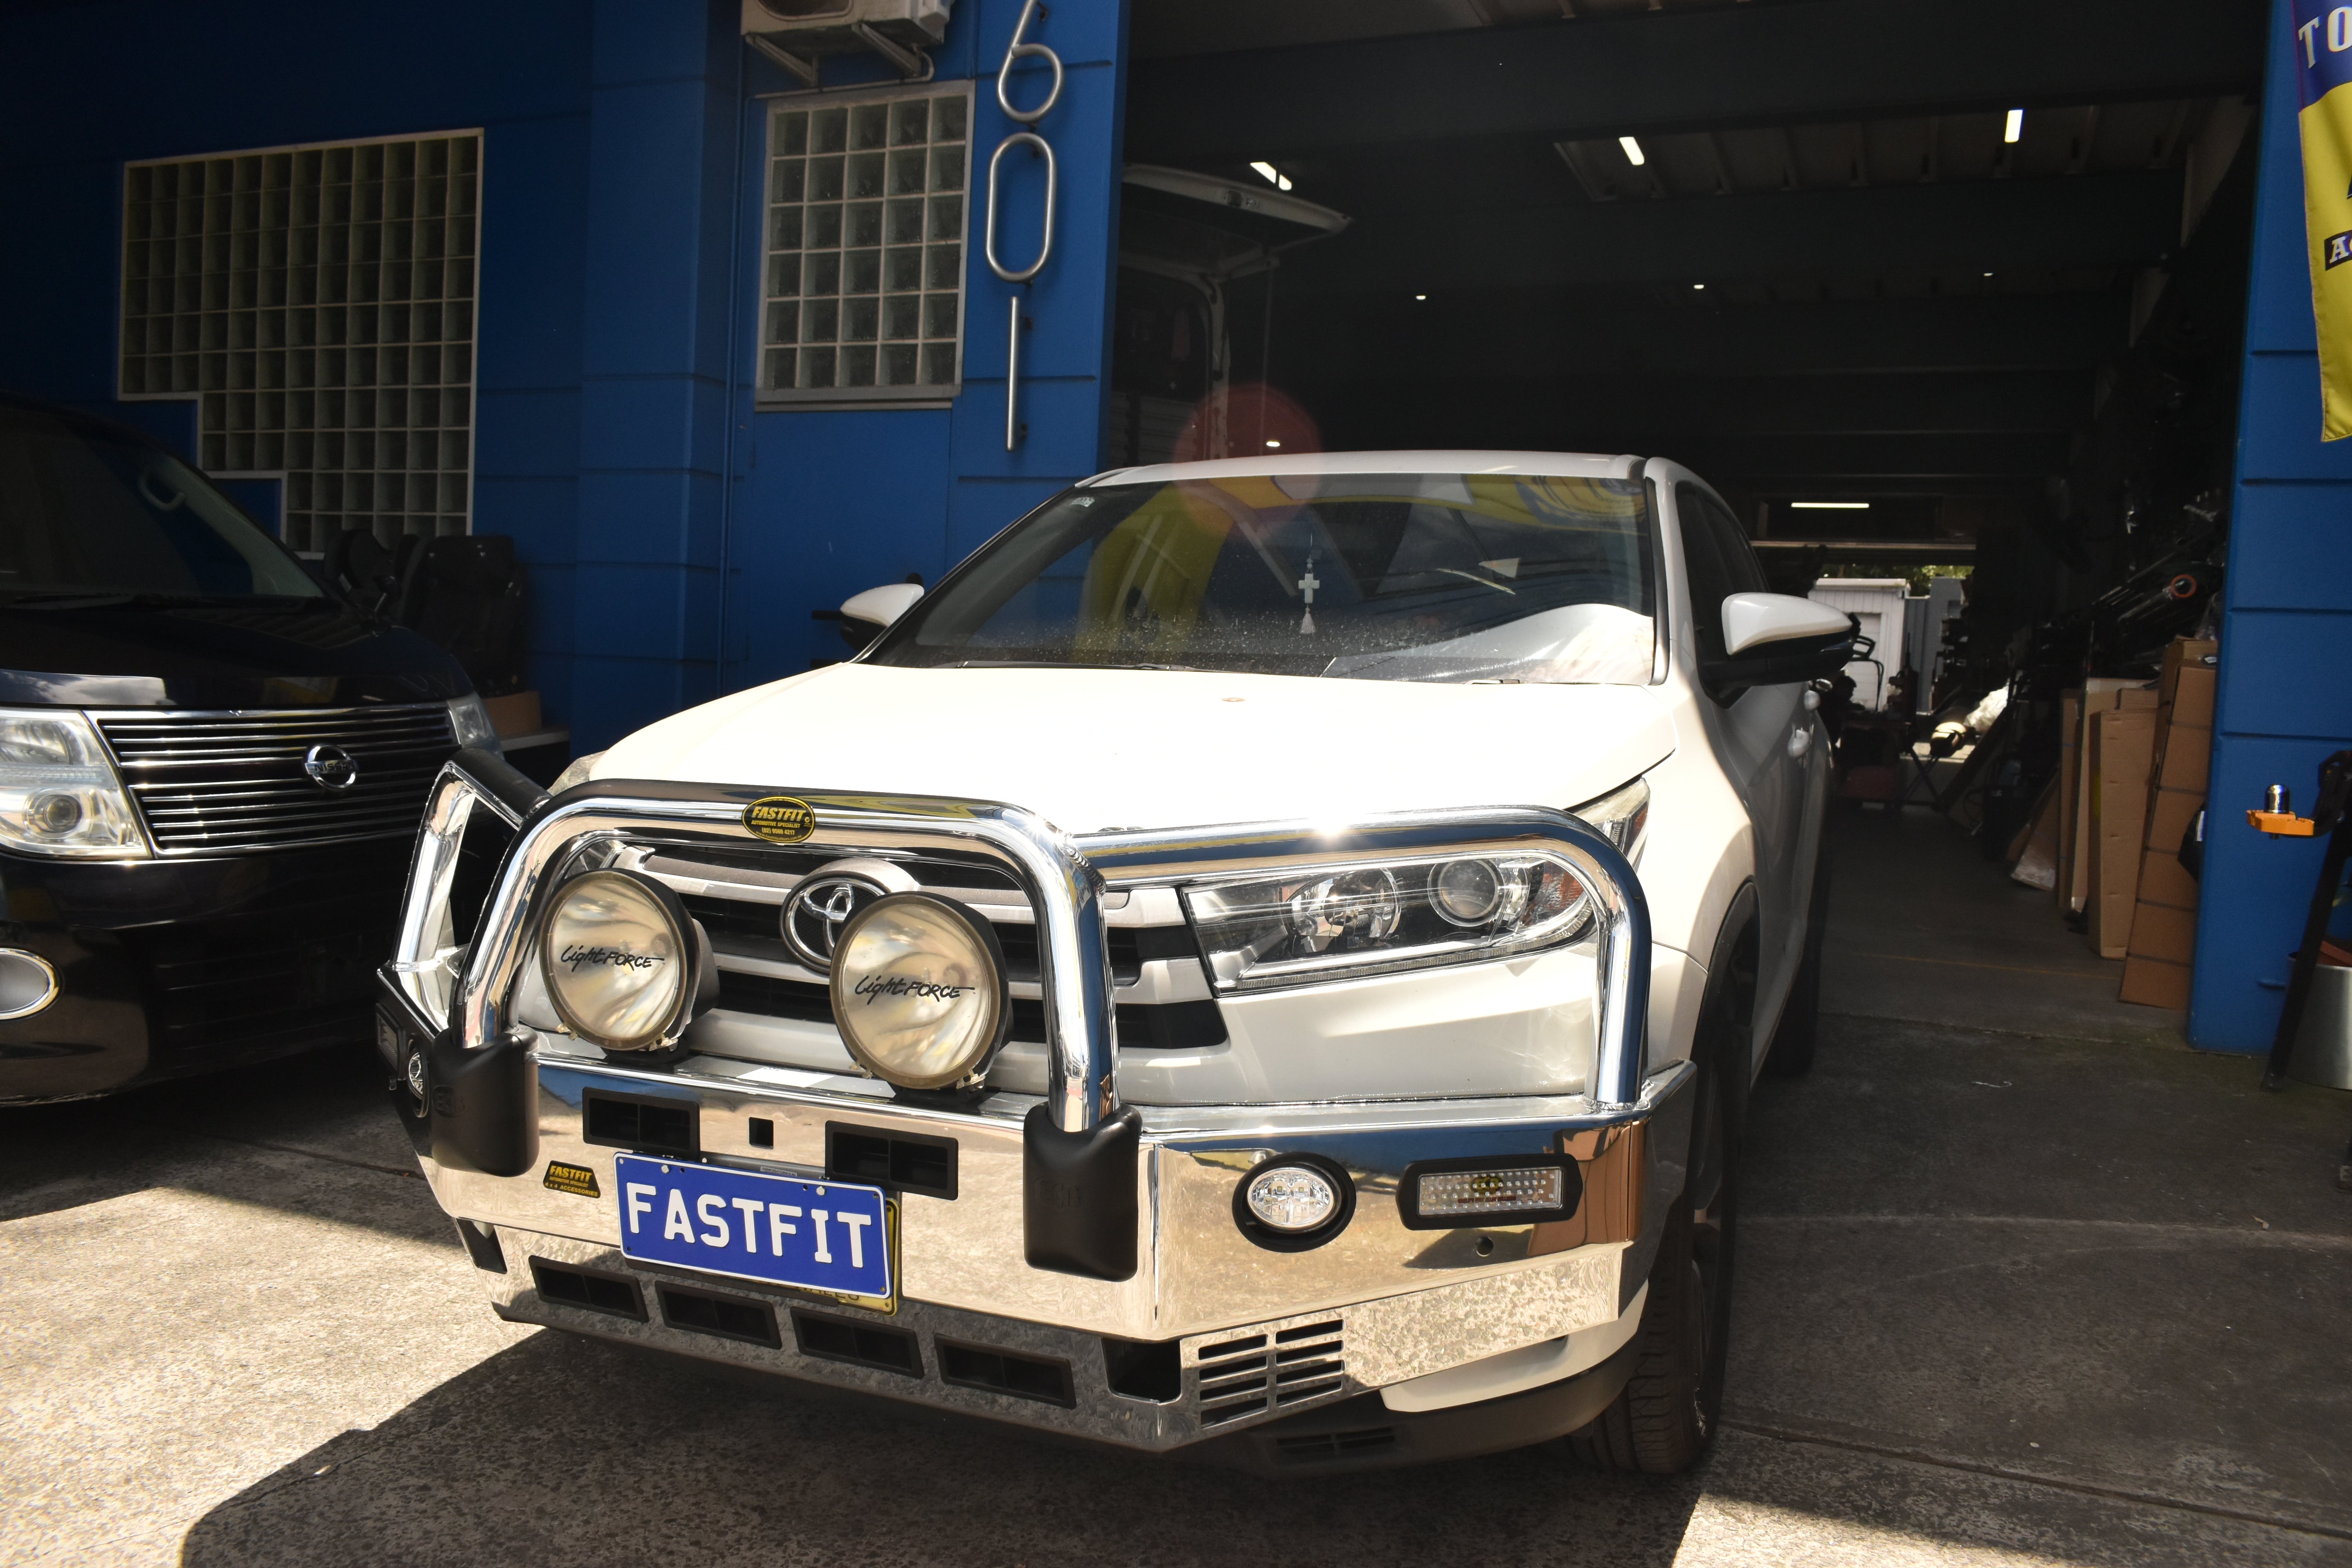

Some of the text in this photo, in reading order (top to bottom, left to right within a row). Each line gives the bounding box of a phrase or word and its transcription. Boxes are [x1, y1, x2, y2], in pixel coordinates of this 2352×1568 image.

[314, 762, 354, 772] NISSAN
[751, 806, 806, 822] FASTFIT
[550, 1165, 592, 1182] FASTFIT
[560, 1185, 598, 1196] ACCESSORIES
[626, 1182, 871, 1268] FASTFIT
